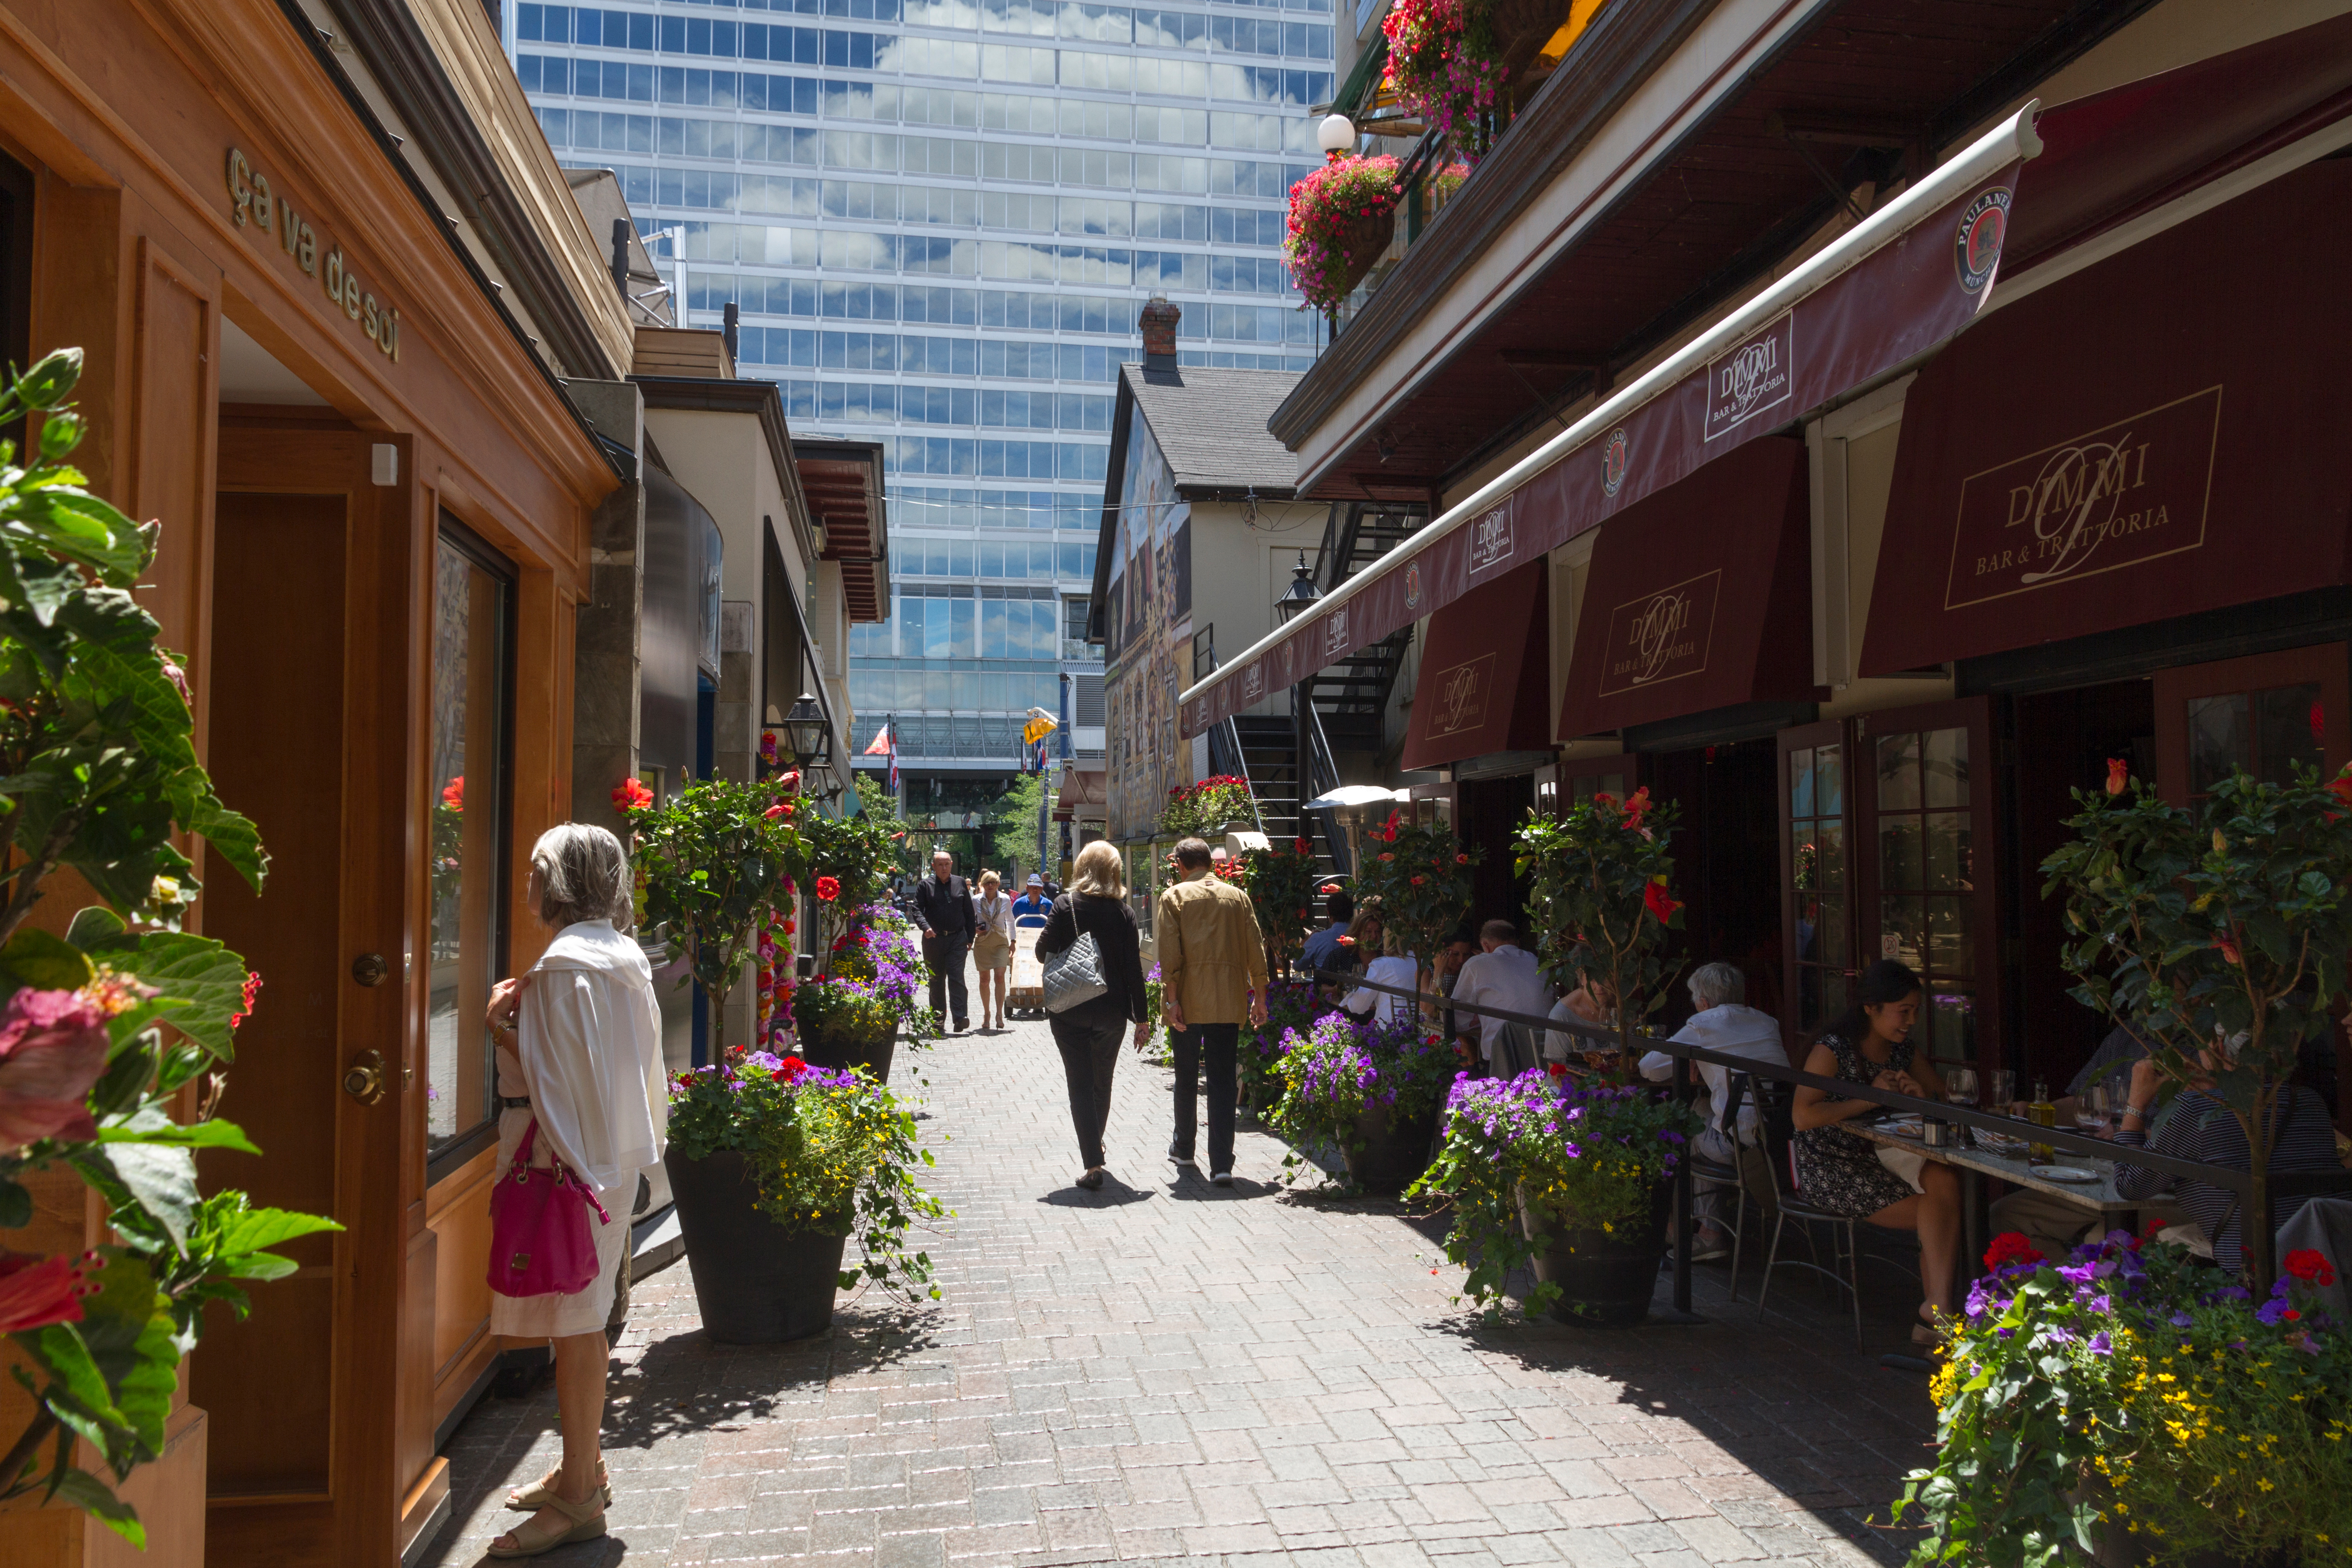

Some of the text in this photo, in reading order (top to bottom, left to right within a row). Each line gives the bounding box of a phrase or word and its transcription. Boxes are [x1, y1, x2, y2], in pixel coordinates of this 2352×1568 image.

[1958, 193, 2011, 245] PAULANER
[227, 147, 399, 363] Ça va de soi
[1721, 337, 1777, 398] DIMMI
[1713, 373, 1785, 421] BAR & TRATTORIA
[1605, 432, 1626, 462] PAULANER
[2005, 443, 2150, 528] DIMMI
[1478, 510, 1504, 544] DIMMI
[1975, 505, 2170, 575] BAR & TRATTORIA
[1473, 550, 1482, 560] BAR
[1629, 600, 1691, 645] DIMMI
[1614, 642, 1694, 675] BAR & TRATTORIA
[1444, 673, 1479, 702] DIMMI
[1434, 714, 1444, 725] BAR
[1449, 704, 1478, 720] TRATTORIA
